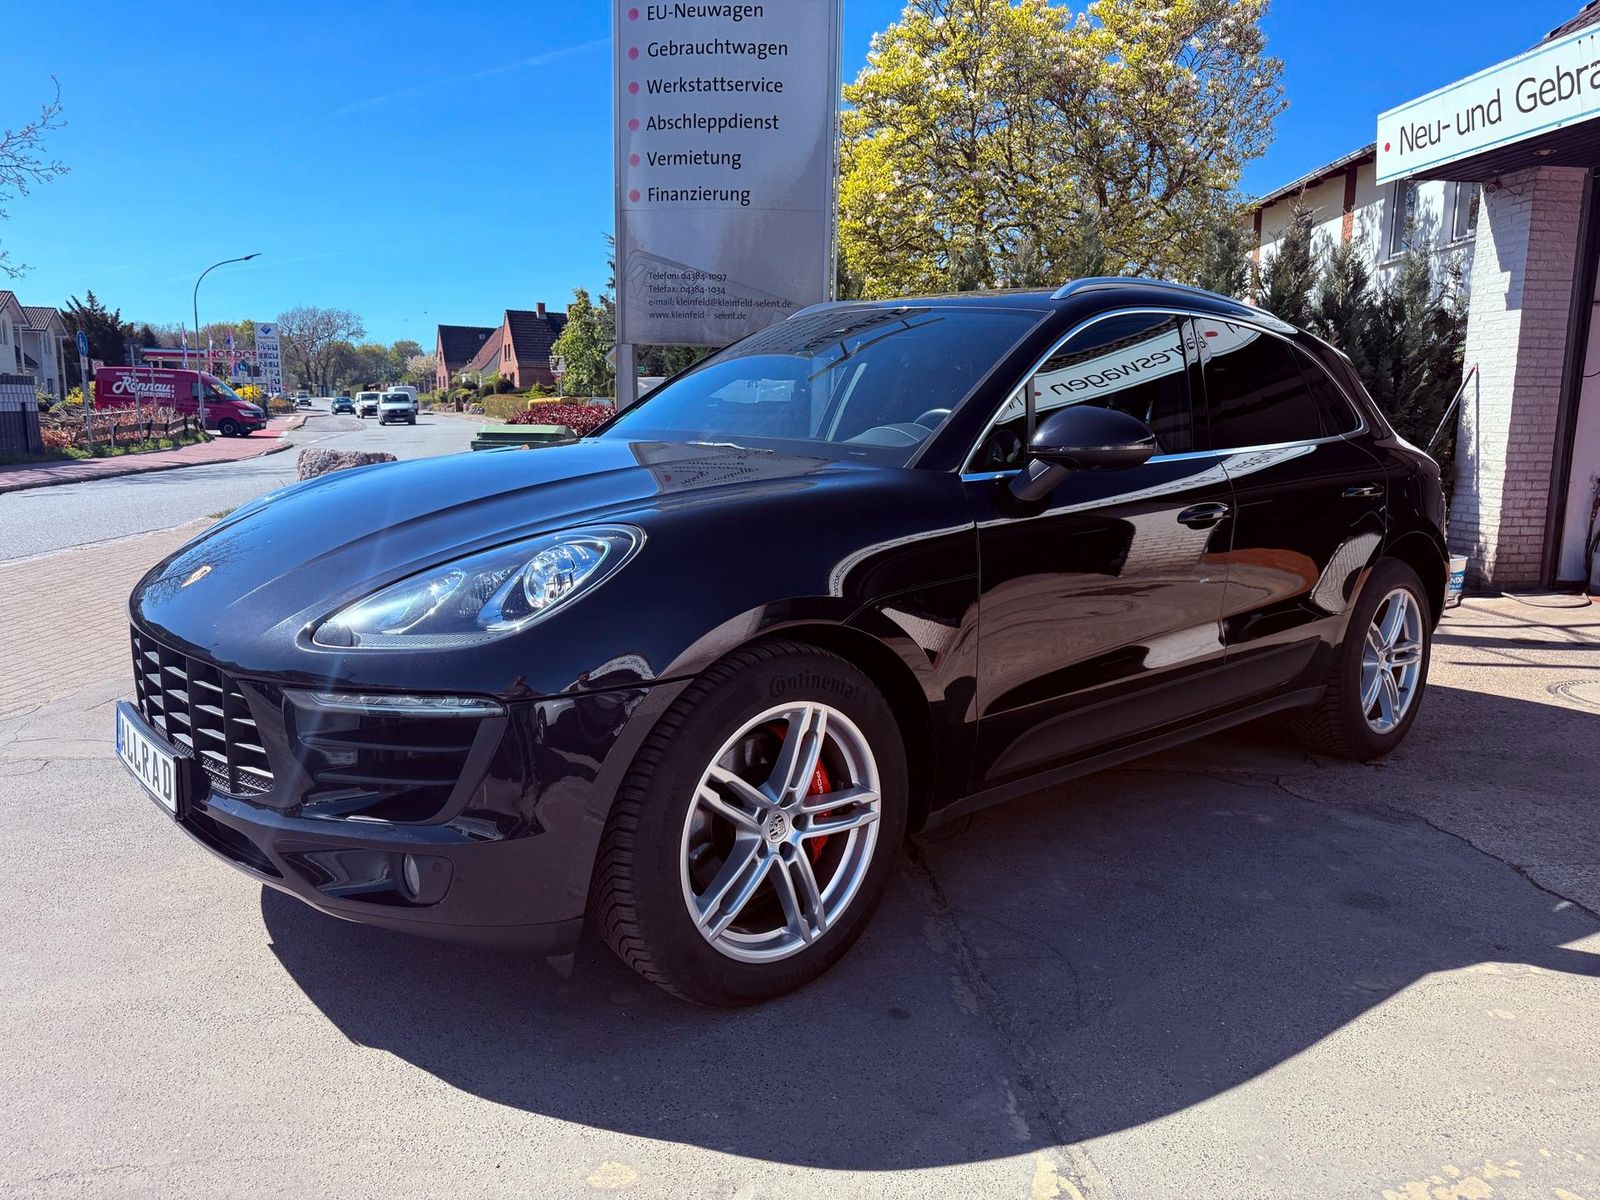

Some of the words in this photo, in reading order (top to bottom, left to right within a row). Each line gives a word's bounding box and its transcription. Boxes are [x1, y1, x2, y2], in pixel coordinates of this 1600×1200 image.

[647, 3, 764, 22] EU-Neuwagen
[647, 38, 788, 60] Gebrauchtwagen
[646, 77, 784, 95] Werkstattservice
[646, 113, 780, 134] Abschleppdienst
[1399, 119, 1451, 156] Neu-
[1456, 87, 1502, 136] und
[646, 150, 742, 170] Vermietung
[647, 186, 751, 206] Finanzierung
[649, 271, 680, 280] Telefon:
[681, 272, 727, 282] 04384-1097
[649, 284, 678, 294] Telefax:
[680, 285, 726, 294] 04384-1034
[648, 297, 675, 306] e-mail:
[676, 297, 792, 308] kleinfeld@kleinfeld-selent.de
[770, 669, 860, 700] Continental
[121, 717, 172, 801] ALLRAD
